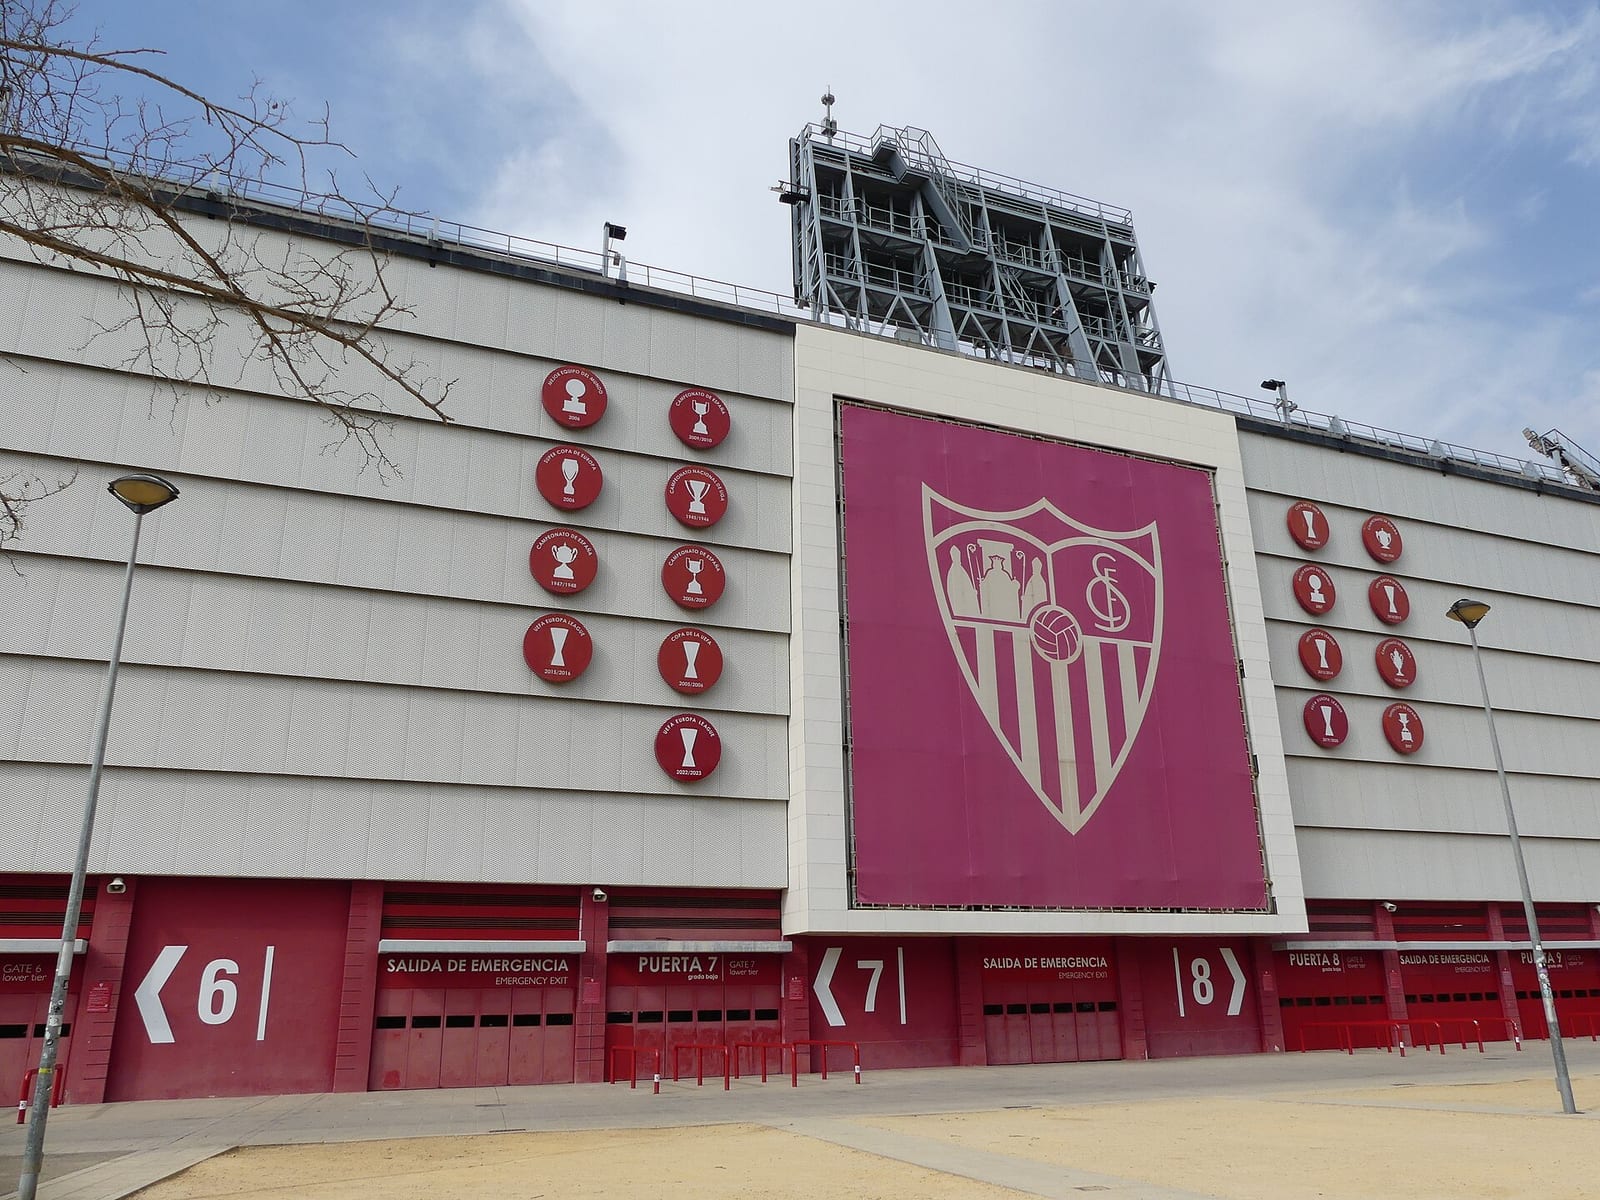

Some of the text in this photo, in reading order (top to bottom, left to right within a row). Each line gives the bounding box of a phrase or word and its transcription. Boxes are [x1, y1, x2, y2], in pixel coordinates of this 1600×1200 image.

[548, 372, 560, 386] MEJOR
[590, 376, 604, 395] MUNDO
[675, 392, 704, 407] CAMPEONATO
[544, 452, 556, 464] SUPER
[580, 453, 597, 471] EUROPA
[669, 469, 692, 494] CAMPEONATO
[692, 469, 717, 484] NACIONAL
[536, 532, 570, 550] CAMPEONATO
[668, 548, 699, 566] CAMPEONATO
[532, 621, 546, 632] UEFA
[568, 620, 586, 636] LEAGUE
[671, 632, 686, 642] COPA
[700, 634, 712, 646] UEFA
[662, 722, 675, 734] UEFA
[698, 720, 714, 737] LEAGUE
[387, 958, 569, 972] SALIDA DE EMERGENCIA
[638, 956, 719, 973] PUERTA 7
[729, 960, 756, 969] GATE 7
[984, 957, 1108, 968] SALIDA DE EMERGENCIA
[1290, 953, 1340, 966] PUERTA 8
[1400, 954, 1490, 965] SALIDA DE EMERGENCIA
[1556, 952, 1562, 964] 9
[3, 964, 42, 973] GATE 6
[495, 976, 568, 986] EMERGENCY EXIT
[858, 960, 884, 1012] 7
[1191, 958, 1214, 1005] 8
[198, 958, 240, 1024] 6
